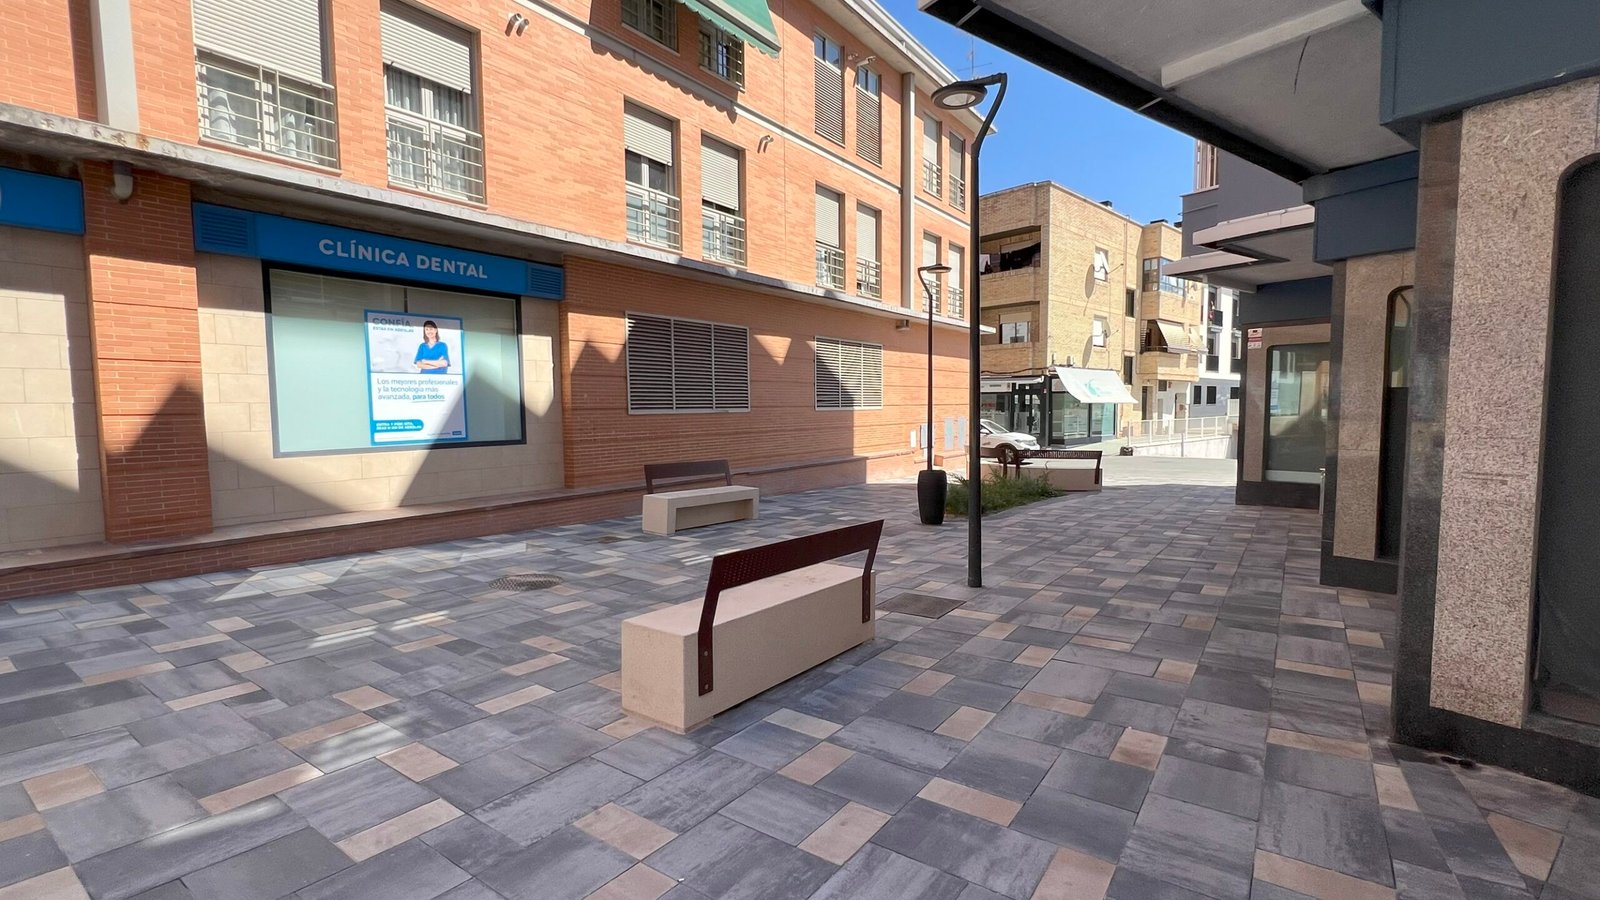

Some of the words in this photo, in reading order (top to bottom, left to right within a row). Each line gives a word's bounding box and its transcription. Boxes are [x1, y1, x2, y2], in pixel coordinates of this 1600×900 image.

[318, 238, 409, 266] CLÍNICA
[416, 254, 488, 278] DENTAL
[418, 378, 458, 387] profesionales
